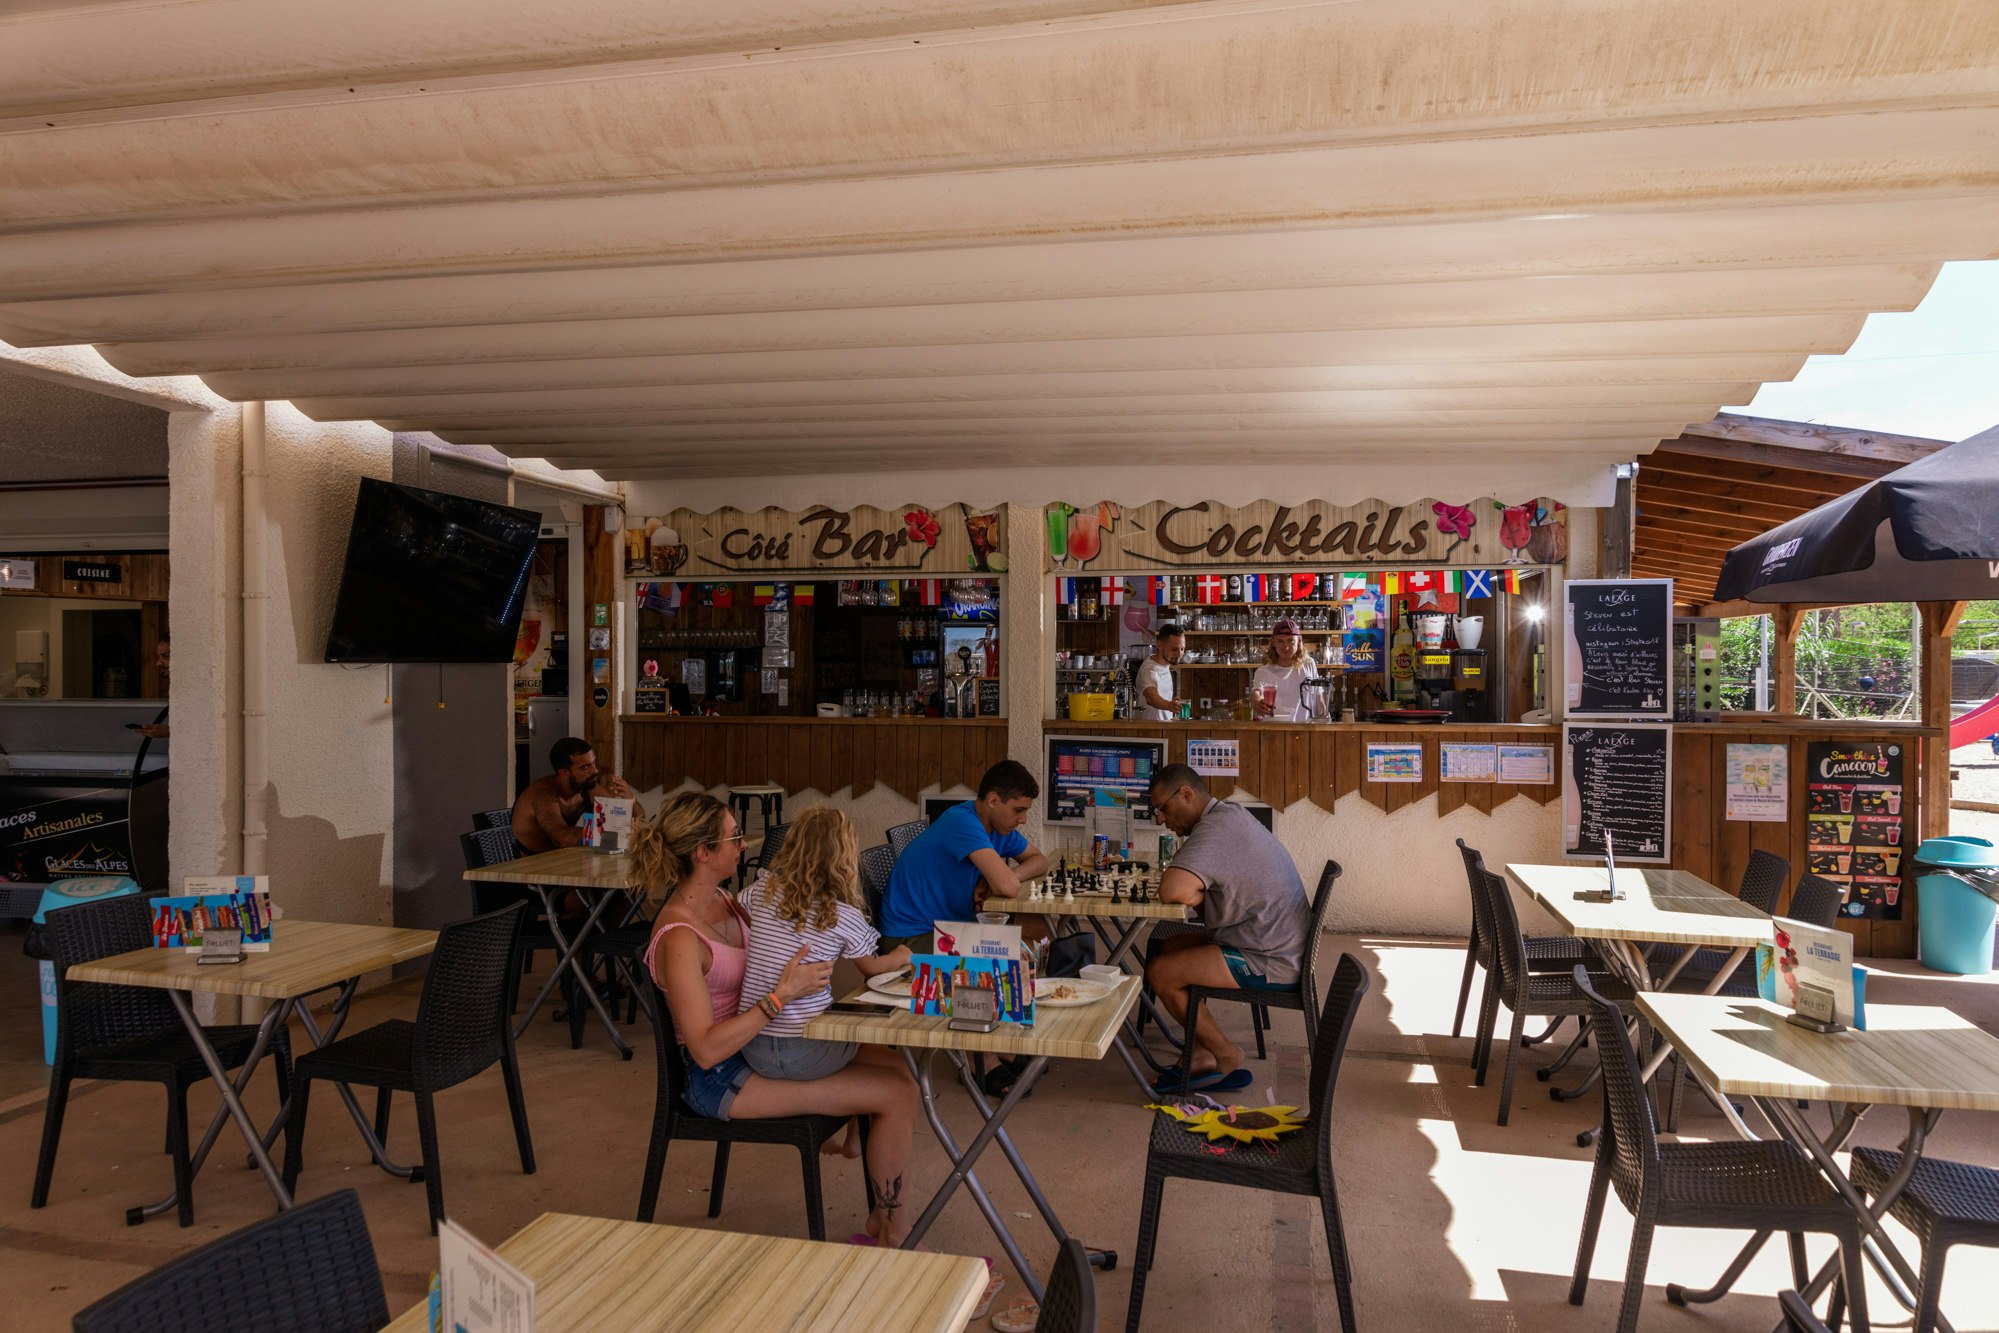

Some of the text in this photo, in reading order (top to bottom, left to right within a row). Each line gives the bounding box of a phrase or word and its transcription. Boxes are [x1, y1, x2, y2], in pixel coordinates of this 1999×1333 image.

[720, 509, 908, 560] Côté Bar
[1156, 501, 1428, 557] Cocktails
[78, 568, 110, 578] CUISINE
[1352, 652, 1374, 661] SUN
[1830, 750, 1876, 760] Smoothies
[1820, 758, 1890, 778] Cancoon
[24, 812, 103, 839] Artisanales
[45, 856, 85, 870] GLACES
[96, 858, 128, 872] ALPES
[972, 945, 1009, 956] LA TERRASSE
[1807, 946, 1840, 962] LA TERRASSE
[958, 1000, 986, 1010] FOLLIET
[1800, 999, 1826, 1010] FOLLIET
